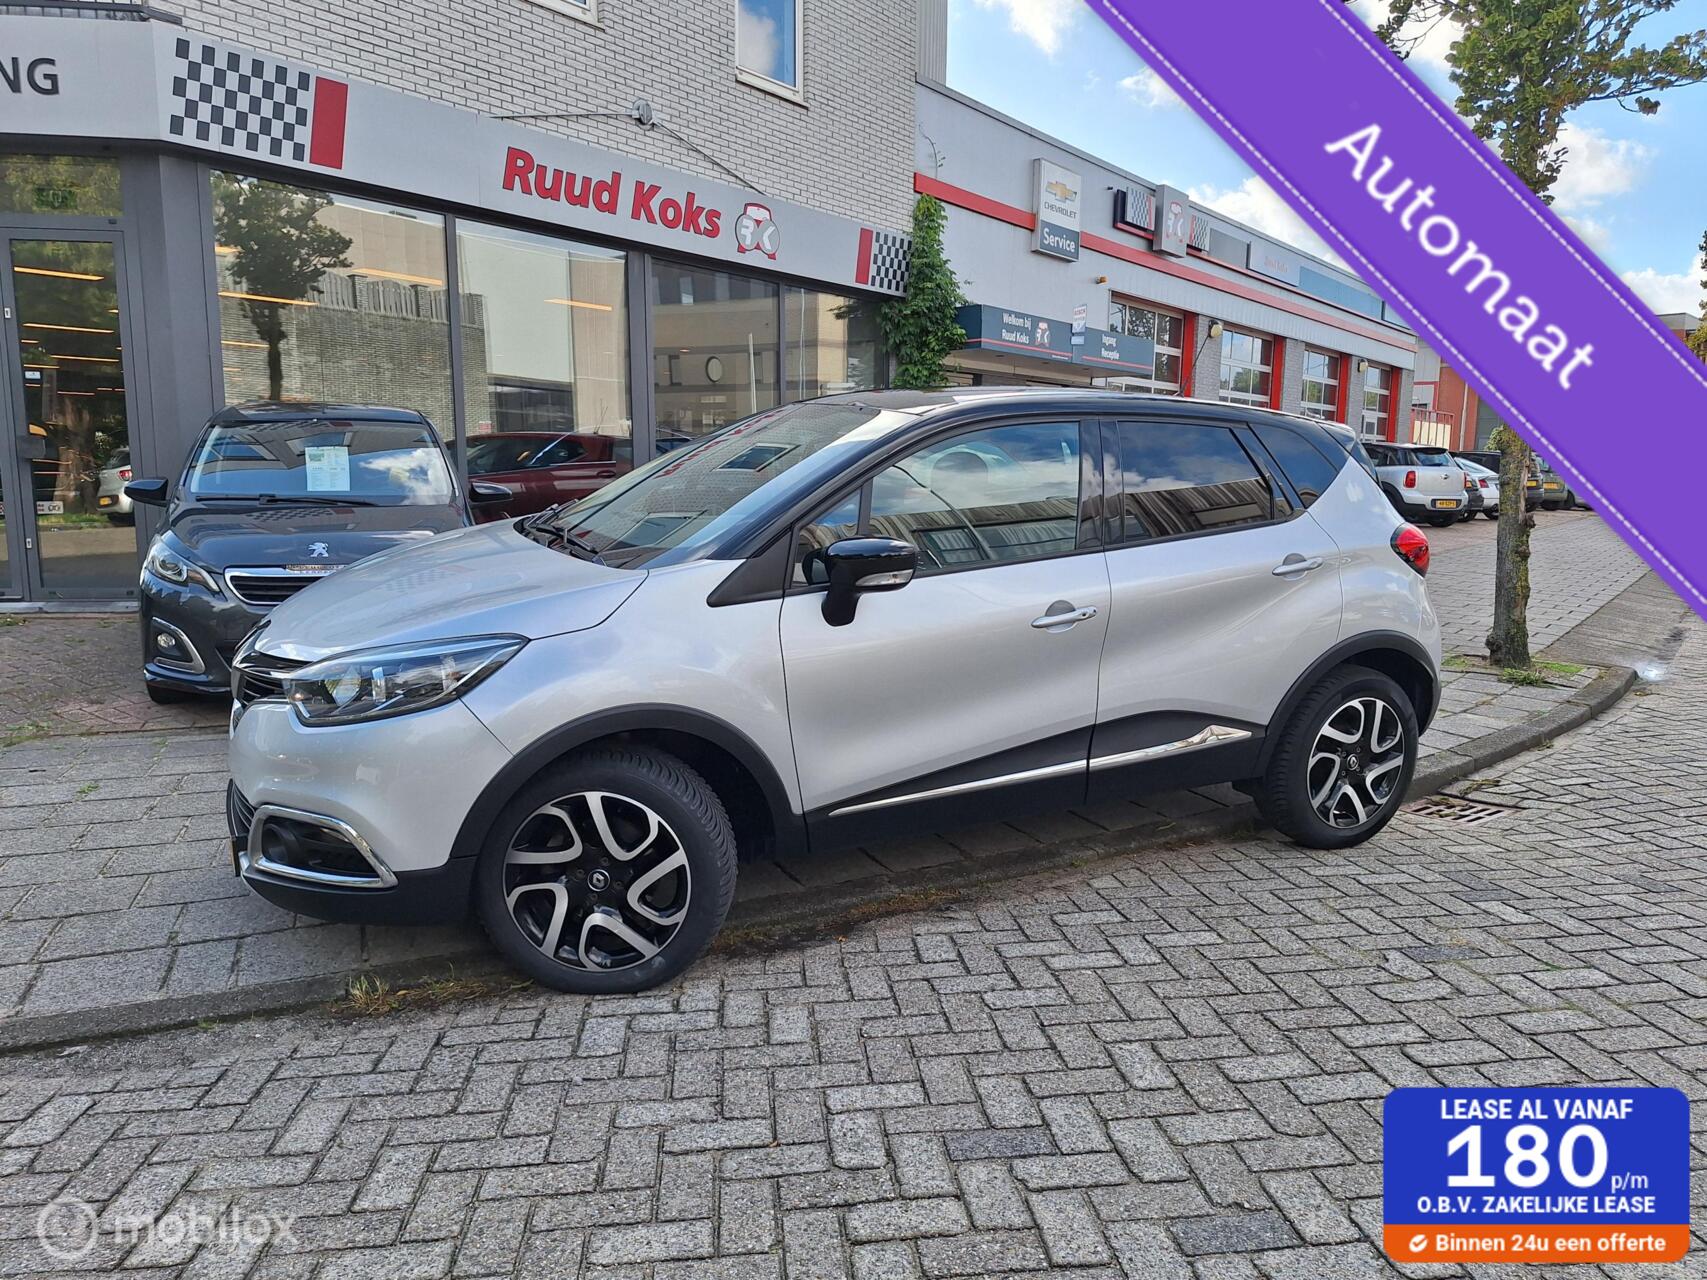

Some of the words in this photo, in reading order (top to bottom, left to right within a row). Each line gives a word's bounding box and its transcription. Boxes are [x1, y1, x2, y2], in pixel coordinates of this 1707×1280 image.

[502, 146, 622, 215] Ruud
[631, 180, 722, 239] Koks
[1044, 201, 1077, 219] CHEVROLET
[1043, 227, 1076, 252] Service
[1002, 312, 1025, 327] Welkom
[1002, 328, 1016, 341] Ruud
[1016, 331, 1030, 344] Koks
